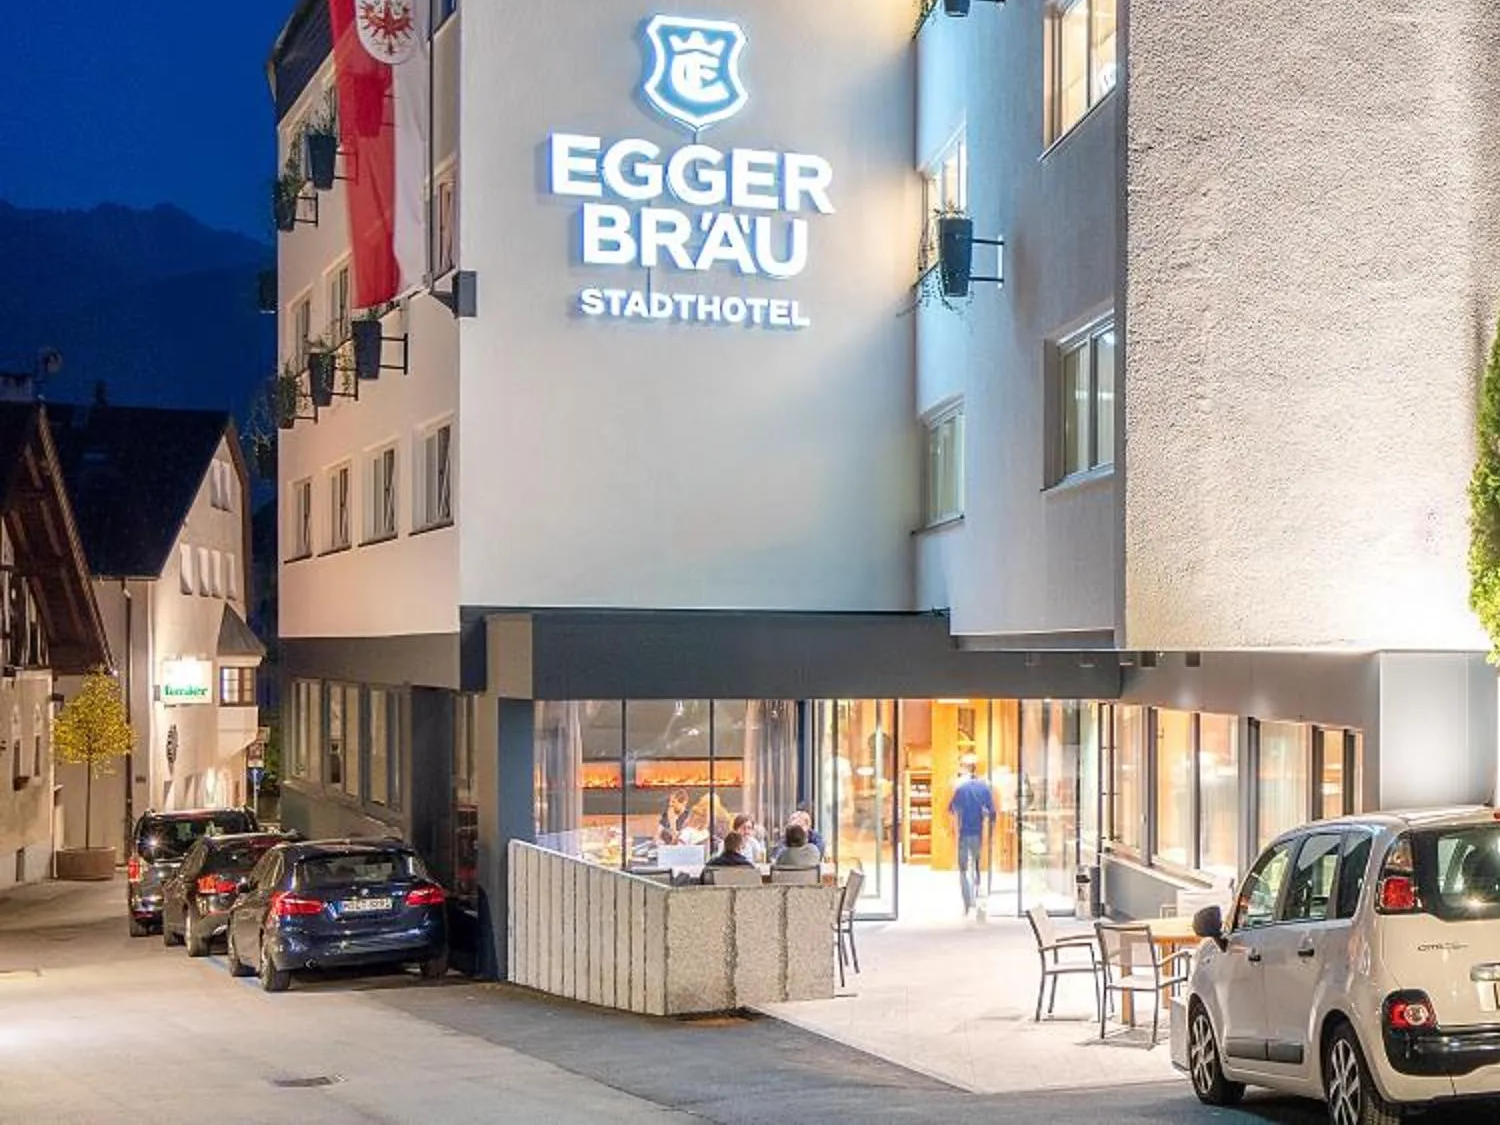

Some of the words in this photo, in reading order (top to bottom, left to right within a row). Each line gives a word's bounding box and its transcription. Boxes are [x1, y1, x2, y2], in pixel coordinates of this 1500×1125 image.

[551, 132, 837, 215] EGGER
[582, 202, 809, 278] BRÄU
[580, 287, 811, 326] STADTHOTEL
